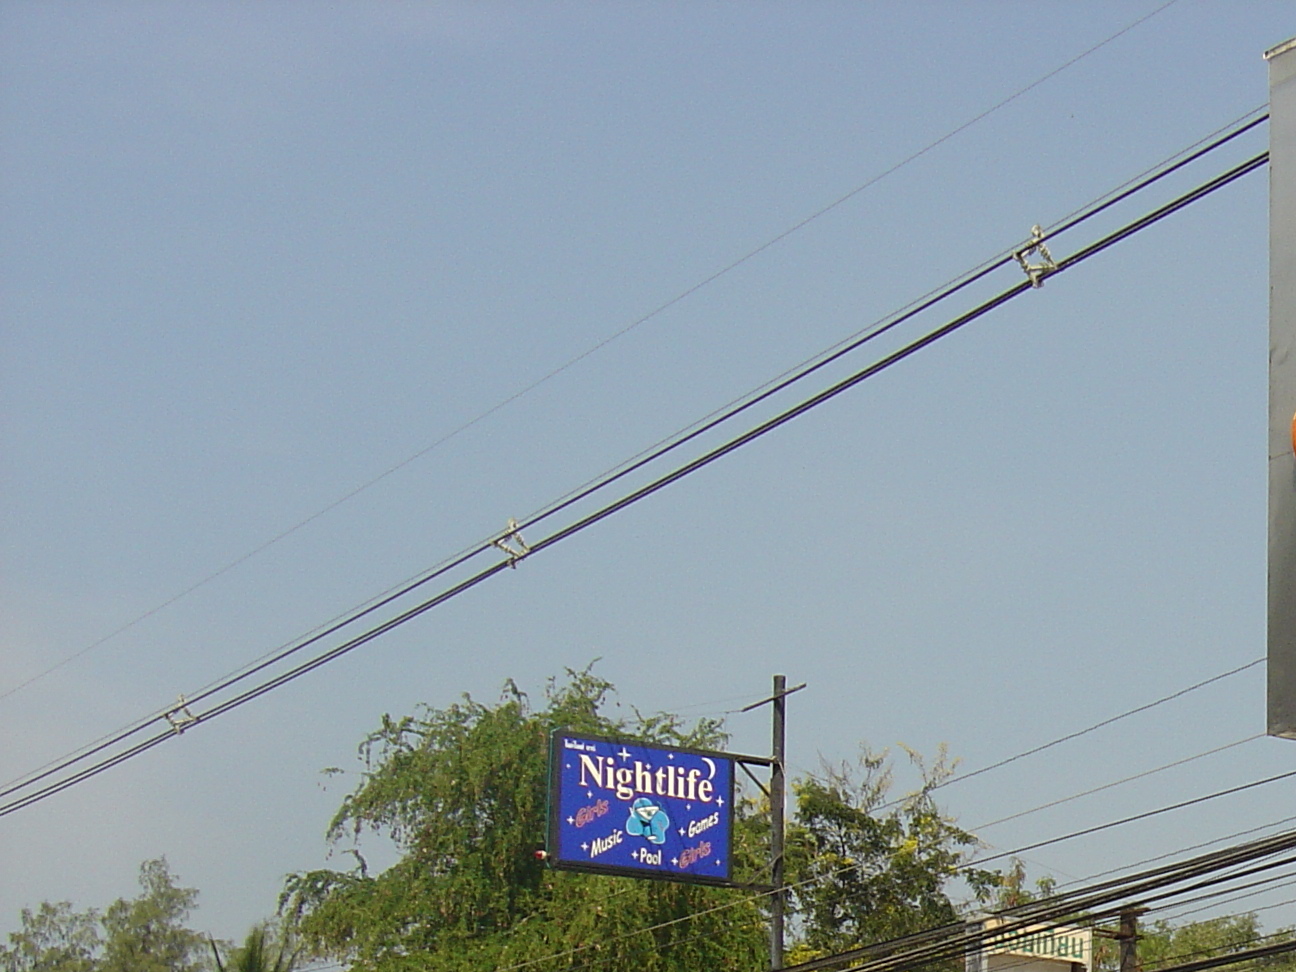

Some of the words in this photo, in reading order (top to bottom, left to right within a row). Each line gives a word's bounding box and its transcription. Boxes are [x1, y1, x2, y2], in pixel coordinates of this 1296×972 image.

[578, 754, 713, 802] Nightlife
[575, 799, 610, 828] Girls
[688, 812, 720, 838] Games
[590, 829, 624, 858] Music
[639, 848, 662, 865] Pool
[679, 840, 712, 868] Girls
